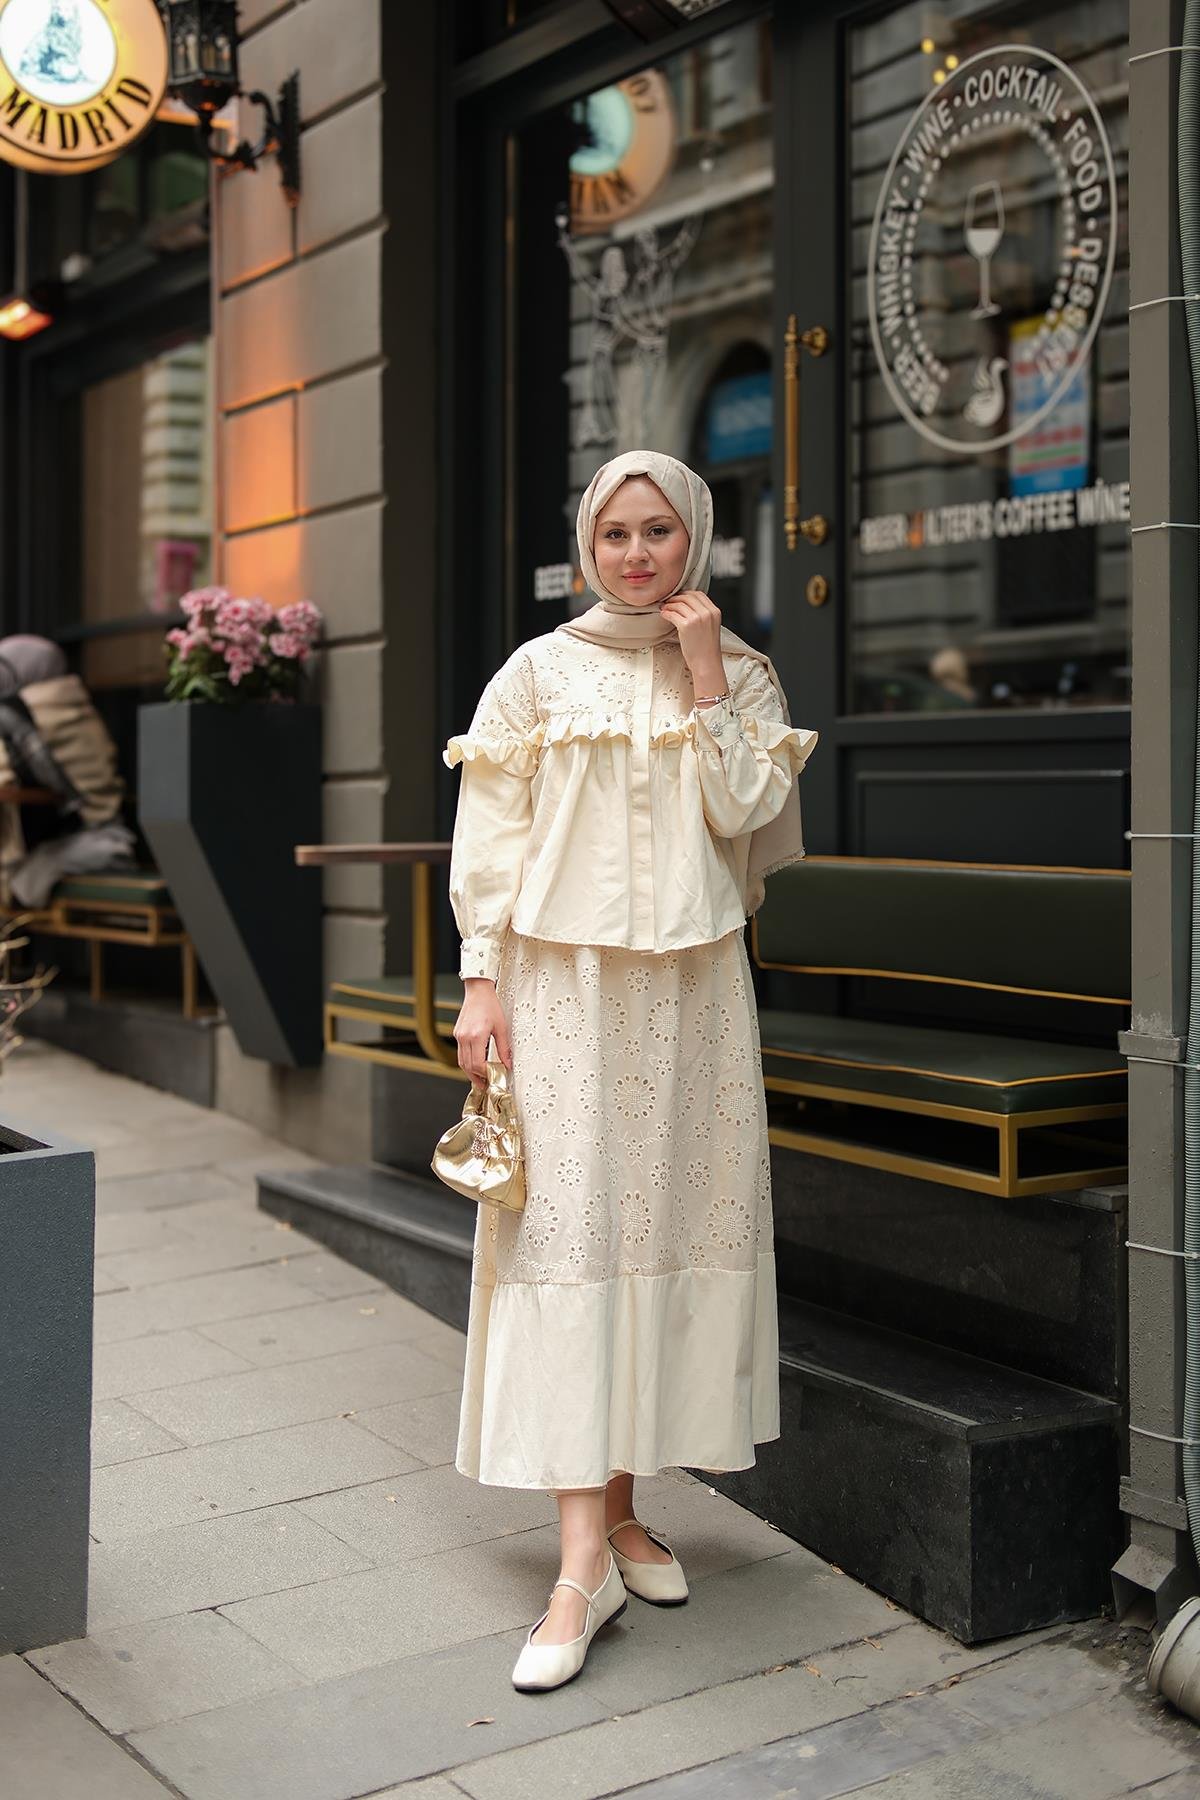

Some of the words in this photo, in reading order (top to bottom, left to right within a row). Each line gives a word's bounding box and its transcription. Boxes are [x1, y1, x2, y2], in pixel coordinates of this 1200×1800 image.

[879, 188, 910, 337] WHISKEY
[904, 98, 954, 174] WINE
[965, 65, 1063, 123] COCKTAIL
[1063, 118, 1102, 212] FOOD
[861, 512, 908, 555] BEER
[995, 489, 1075, 537] COFFEE
